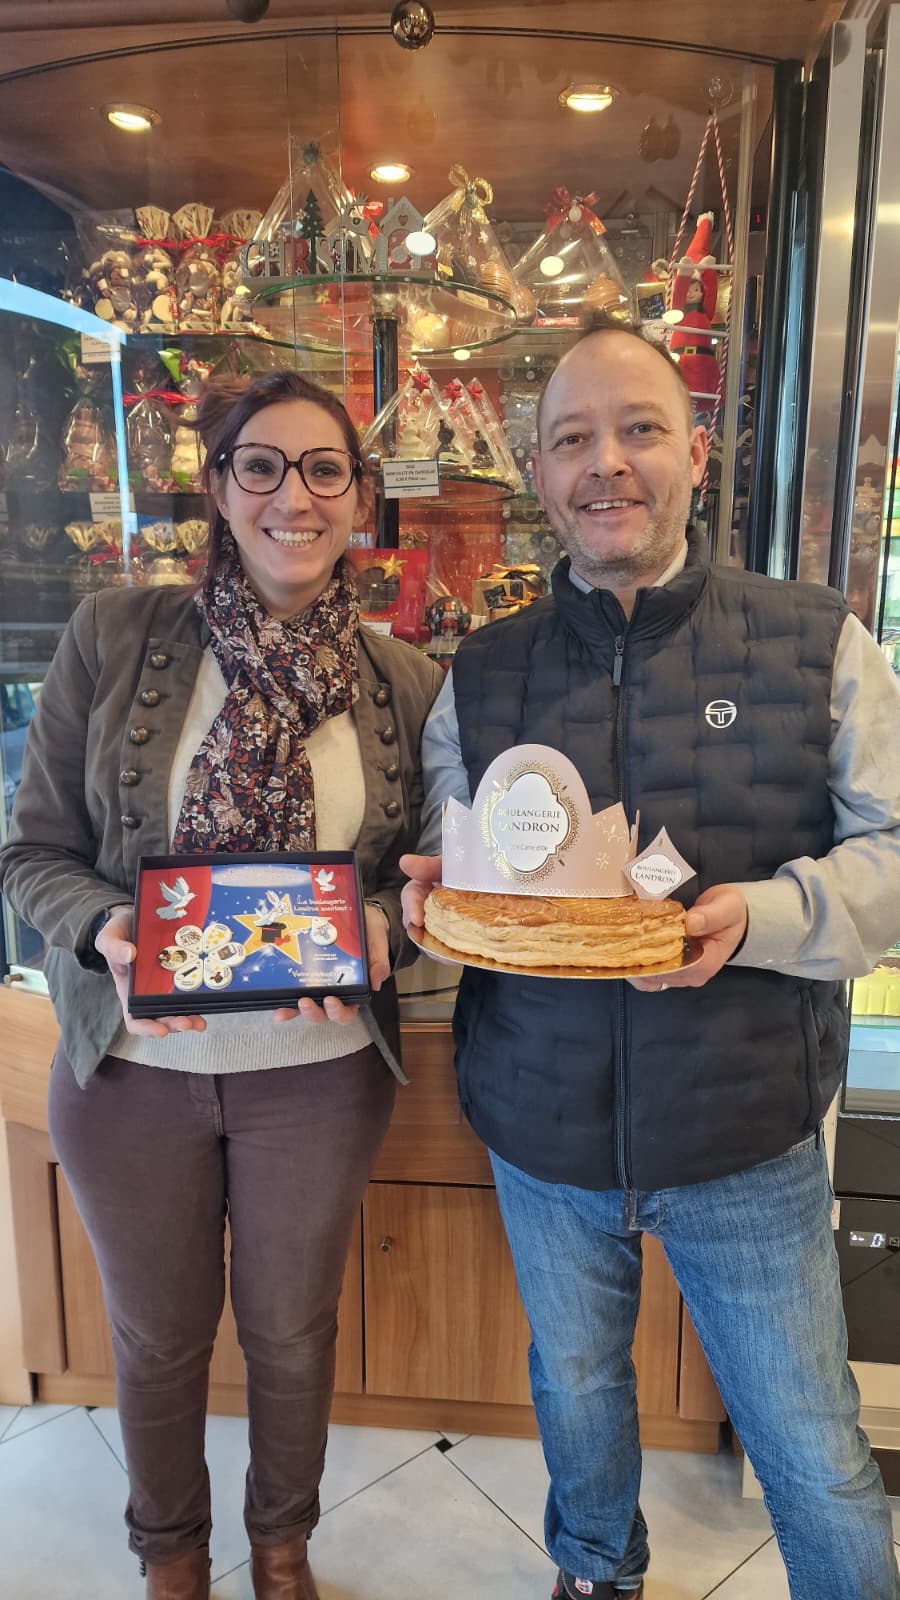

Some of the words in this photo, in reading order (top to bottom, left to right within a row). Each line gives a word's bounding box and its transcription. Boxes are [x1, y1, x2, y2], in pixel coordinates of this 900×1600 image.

[498, 808, 561, 819] BOULANGERIE
[498, 821, 561, 833] LANDRON
[634, 872, 676, 884] LANDRON
